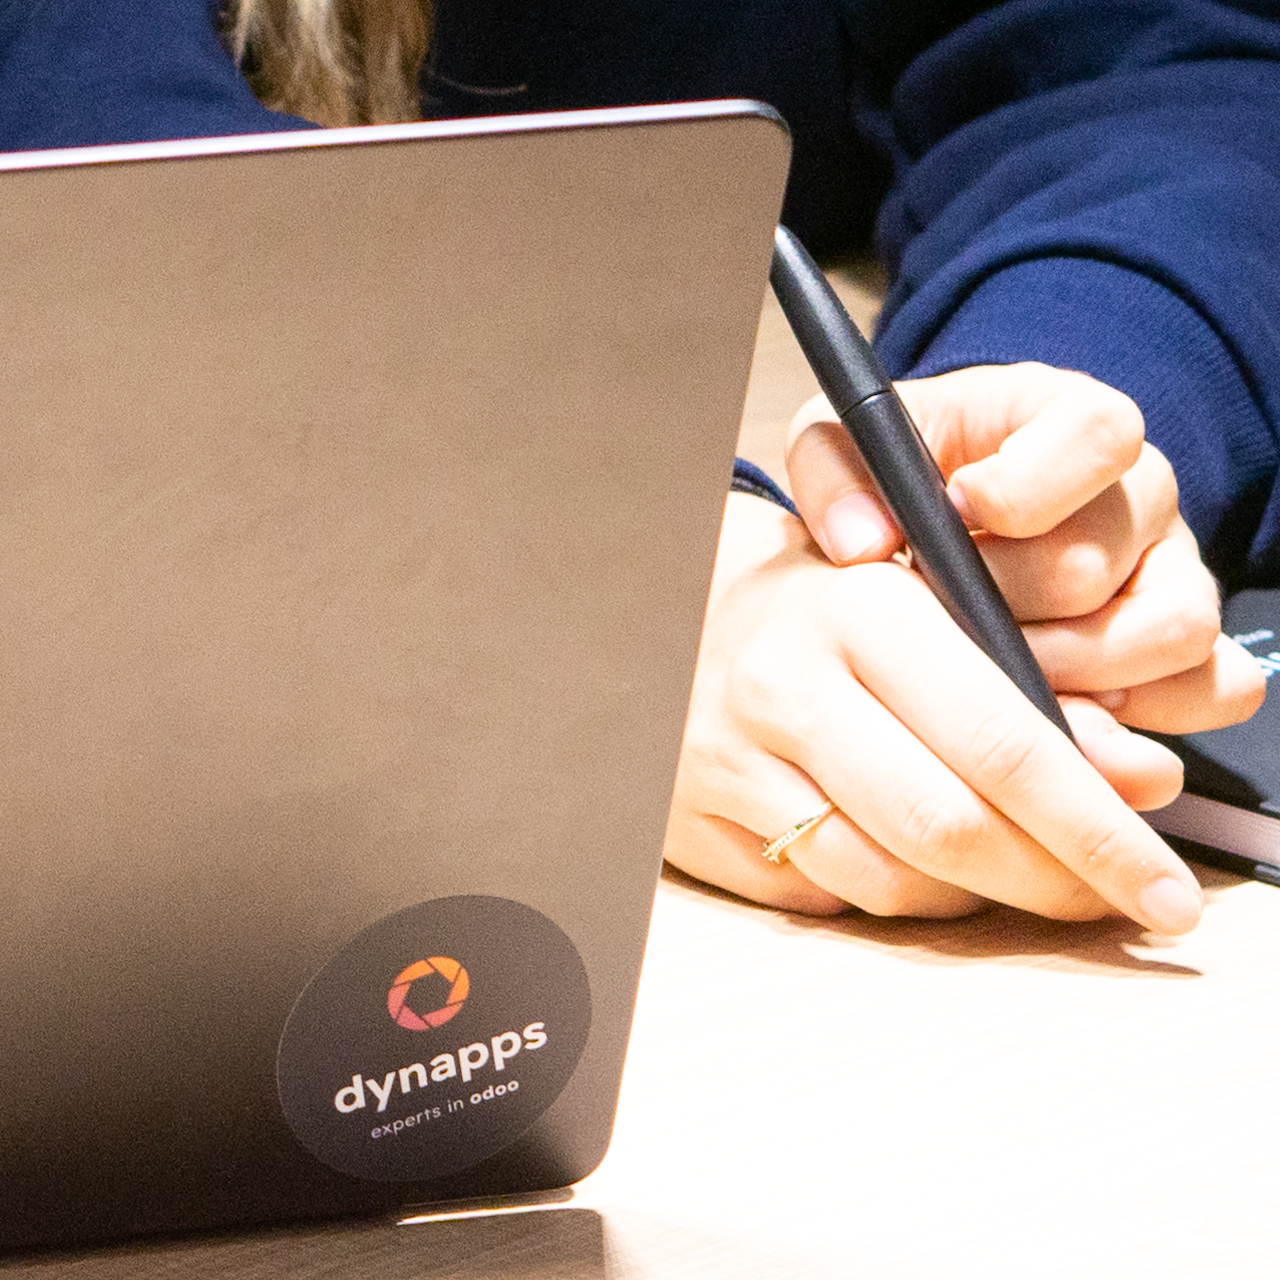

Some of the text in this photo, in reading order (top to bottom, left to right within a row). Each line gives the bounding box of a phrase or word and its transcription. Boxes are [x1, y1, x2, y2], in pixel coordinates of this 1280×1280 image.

[334, 1021, 548, 1114] dynapps
[371, 1080, 519, 1139] experts in odoo
